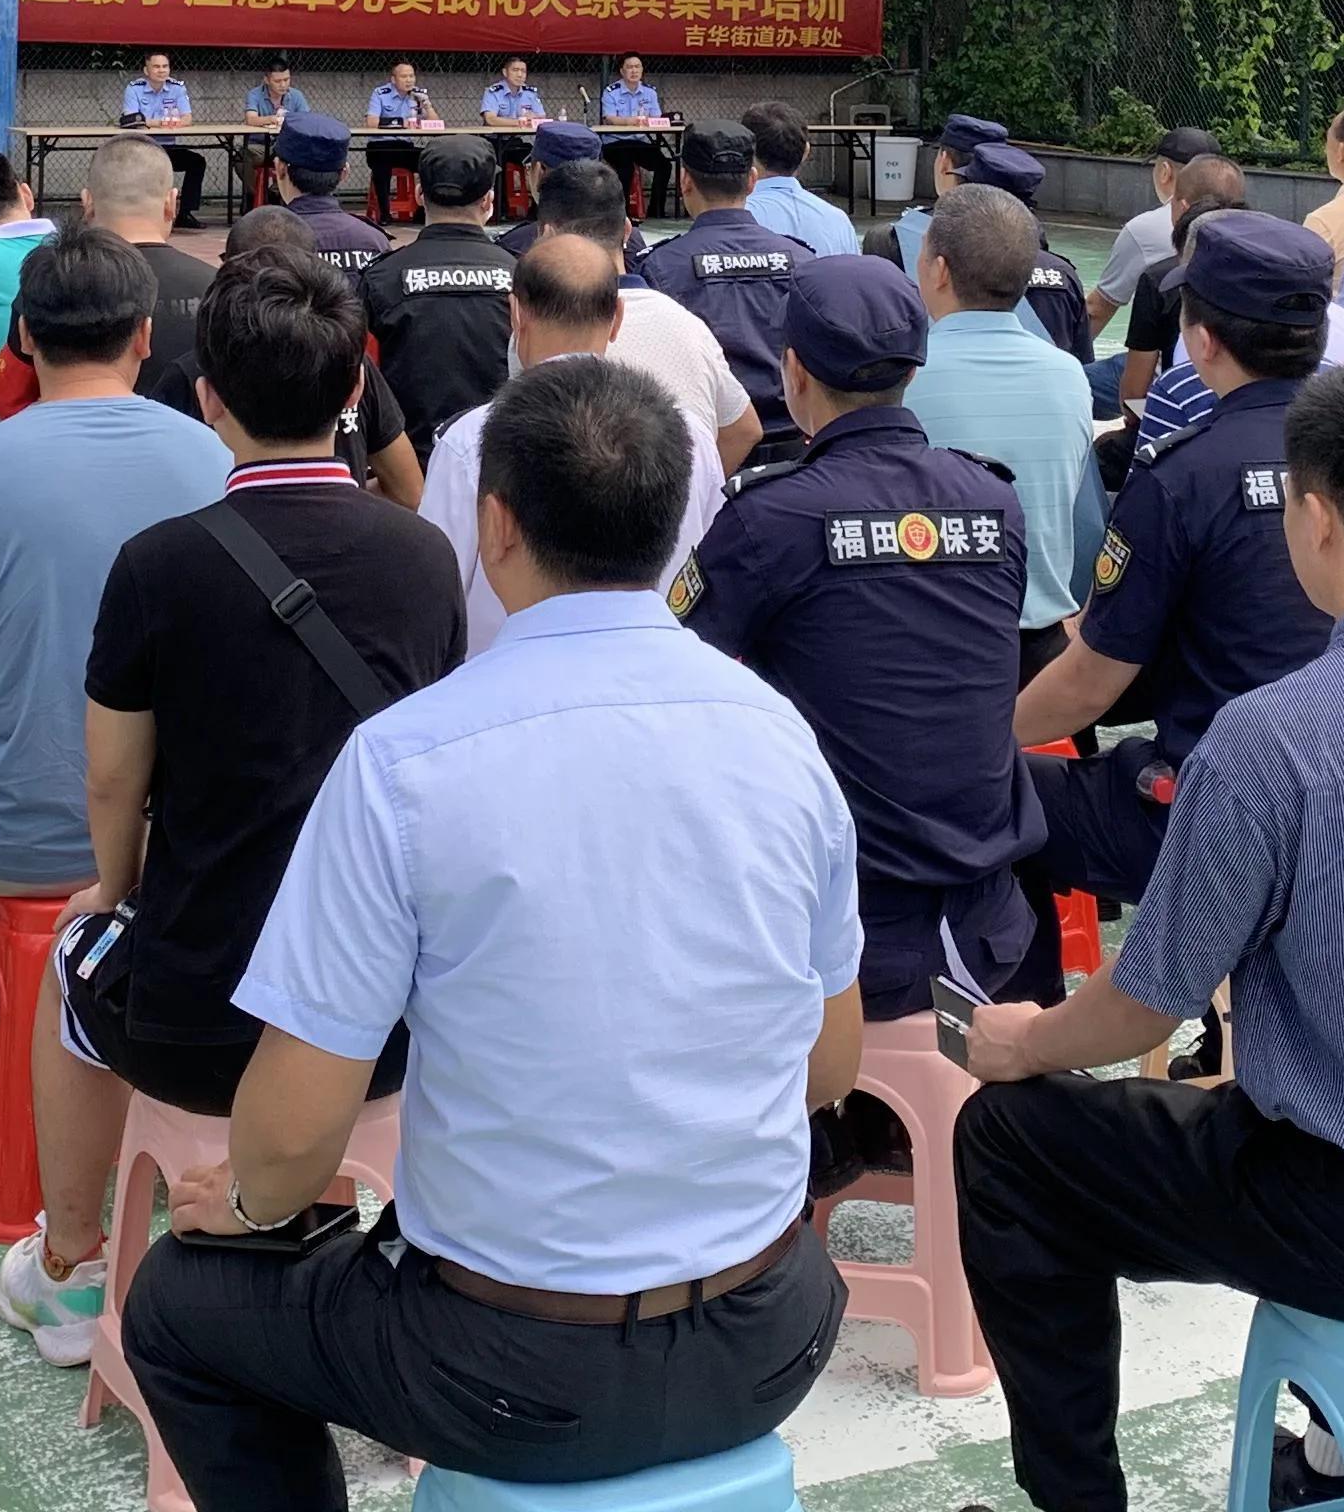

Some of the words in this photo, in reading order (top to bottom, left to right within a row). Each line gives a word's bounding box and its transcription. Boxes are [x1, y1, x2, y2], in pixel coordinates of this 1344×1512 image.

[685, 24, 843, 49] 吉华街道办事处
[701, 252, 789, 274] 保BAOAN安
[405, 268, 513, 292] 保BAOAN安
[1245, 470, 1288, 506] 福
[830, 519, 900, 560] 福田
[939, 515, 1001, 555] 保安
